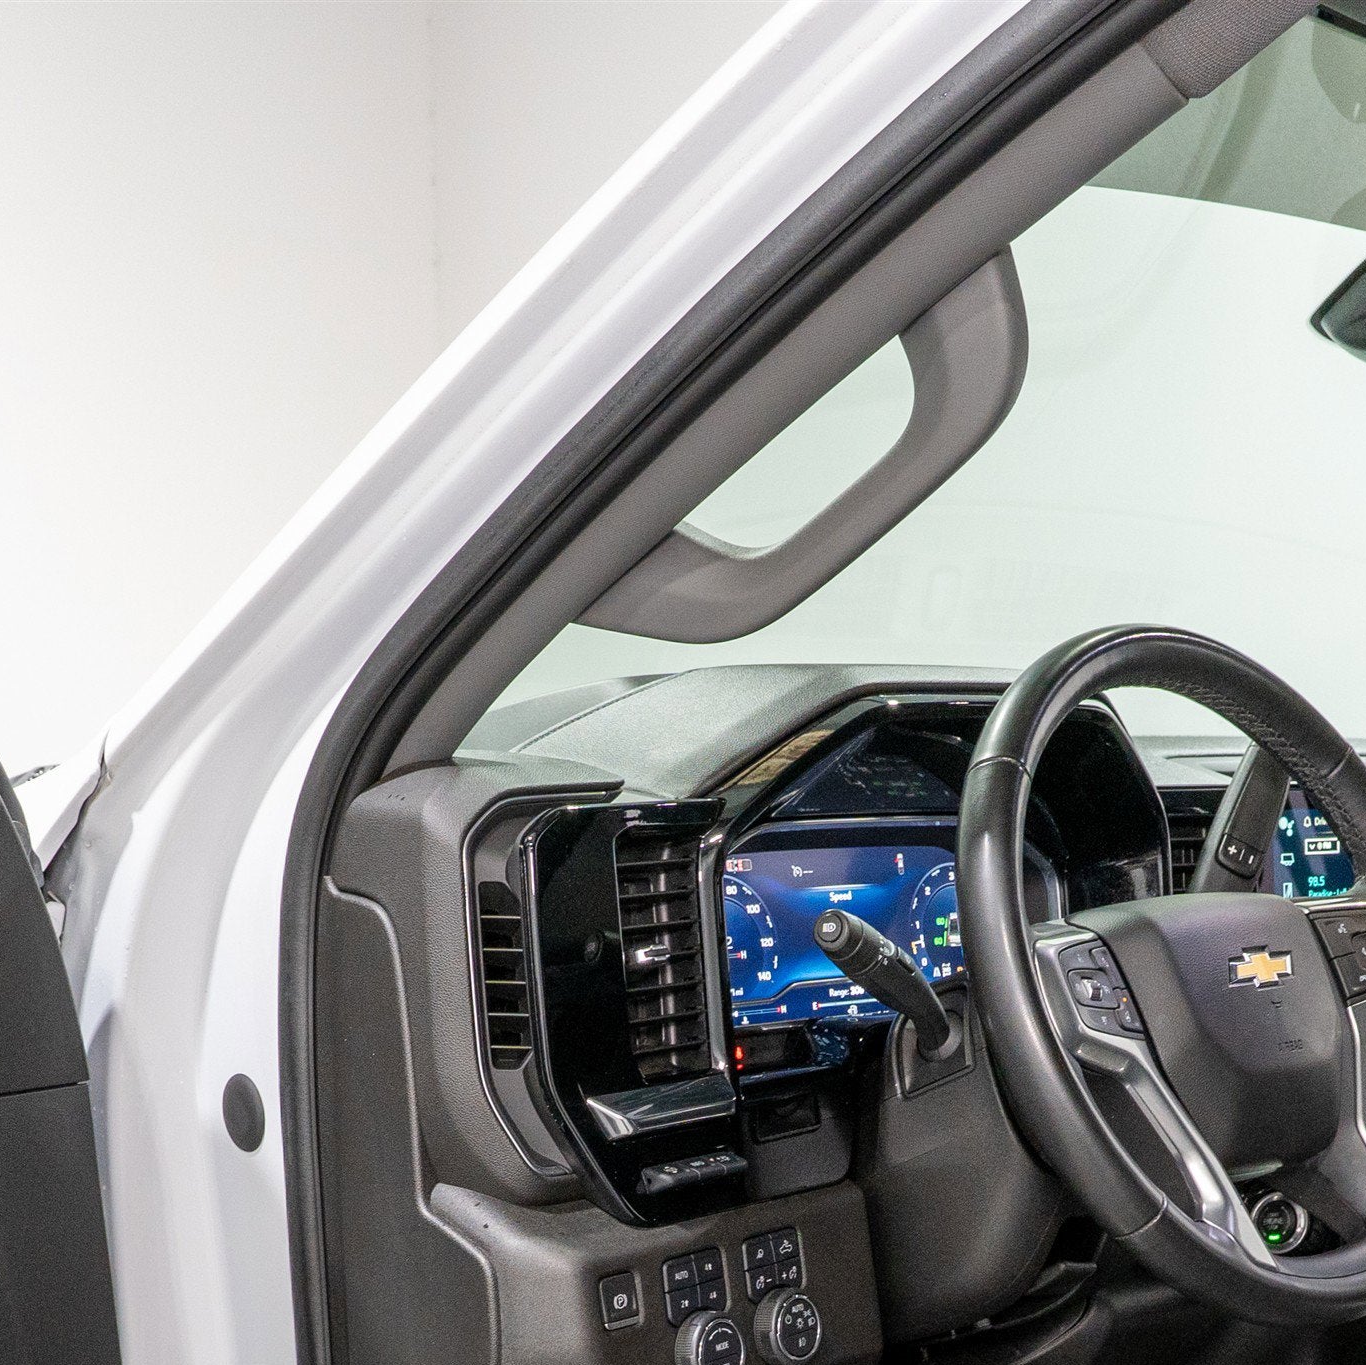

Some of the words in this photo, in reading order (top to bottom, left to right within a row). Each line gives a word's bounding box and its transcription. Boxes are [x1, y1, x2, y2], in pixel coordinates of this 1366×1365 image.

[725, 885, 738, 895] 80
[829, 891, 852, 903] Speed
[746, 904, 761, 914] 100
[760, 937, 774, 947] 120
[757, 971, 771, 981] 140
